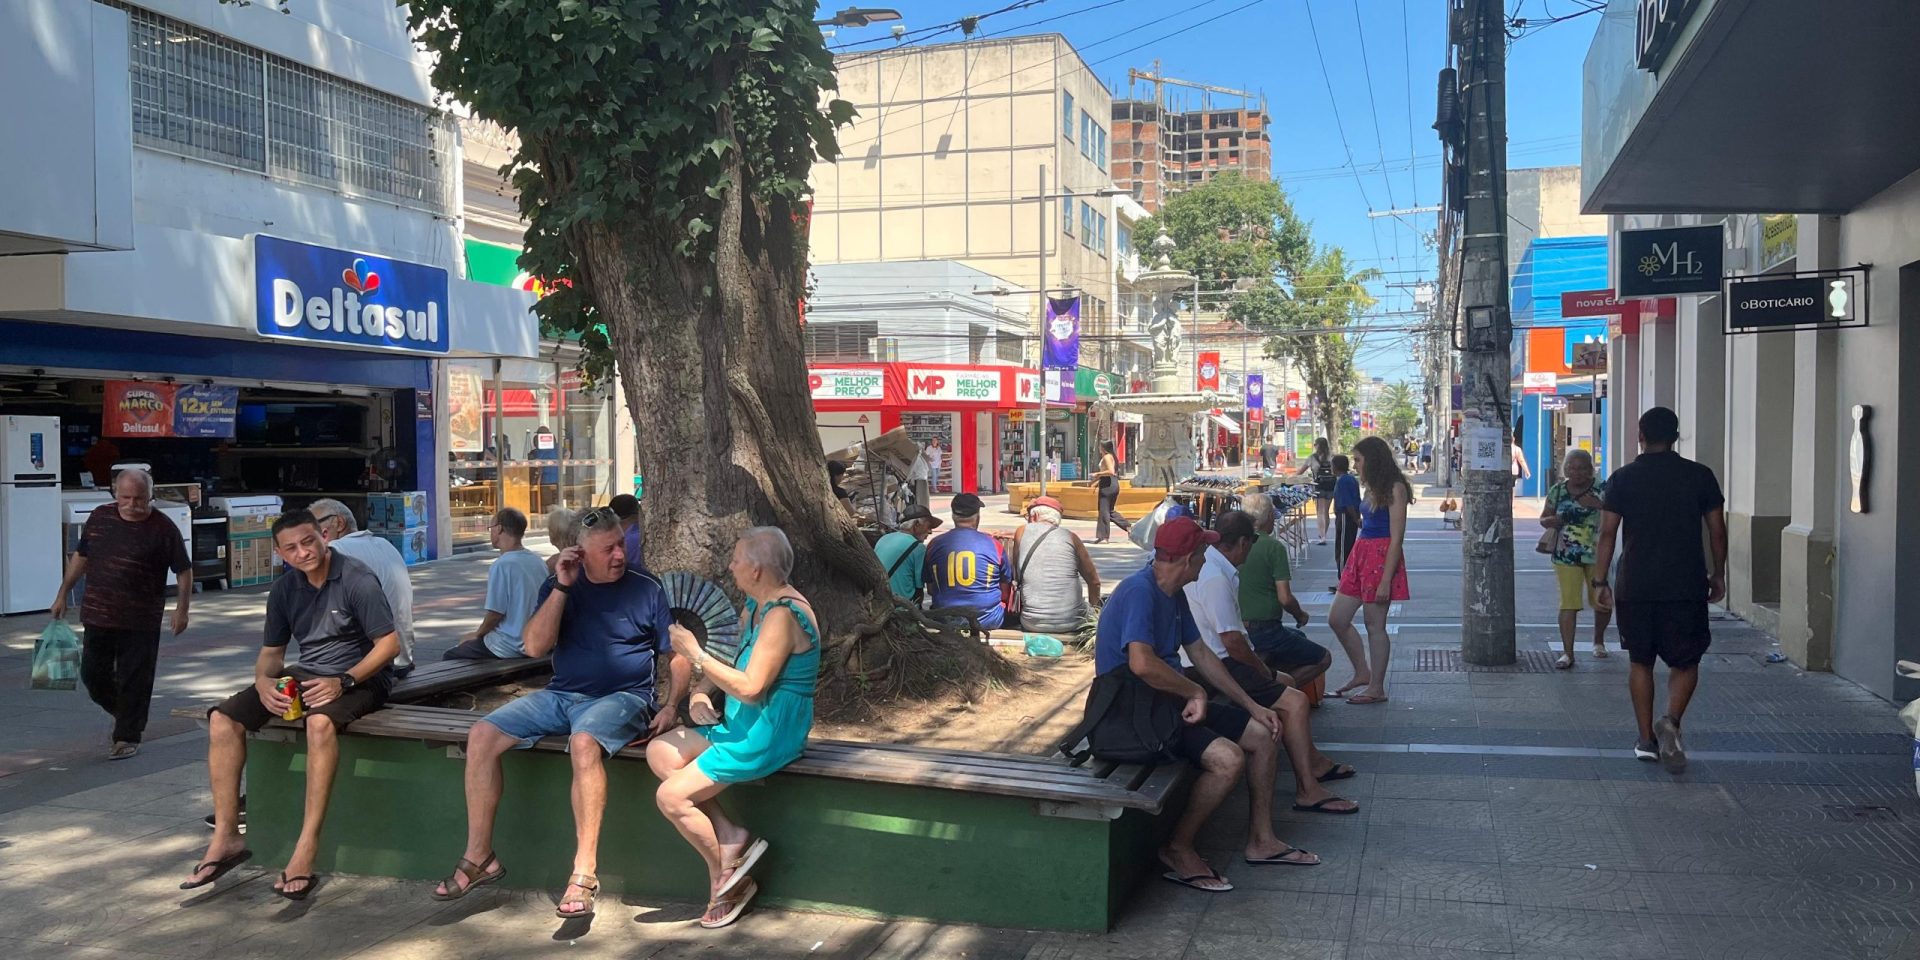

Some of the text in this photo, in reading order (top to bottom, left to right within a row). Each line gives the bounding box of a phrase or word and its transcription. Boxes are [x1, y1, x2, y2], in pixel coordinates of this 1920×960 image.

[273, 278, 438, 343] Deltasul
[835, 377, 879, 386] MELHOR
[913, 375, 945, 395] MP
[956, 379, 997, 388] MELHOR
[126, 390, 155, 399] SUPER
[835, 386, 870, 397] PREÇO
[956, 388, 989, 399] PREÇO
[179, 397, 209, 414] 12x
[122, 422, 160, 433] Deltasul
[947, 550, 976, 587] 10
